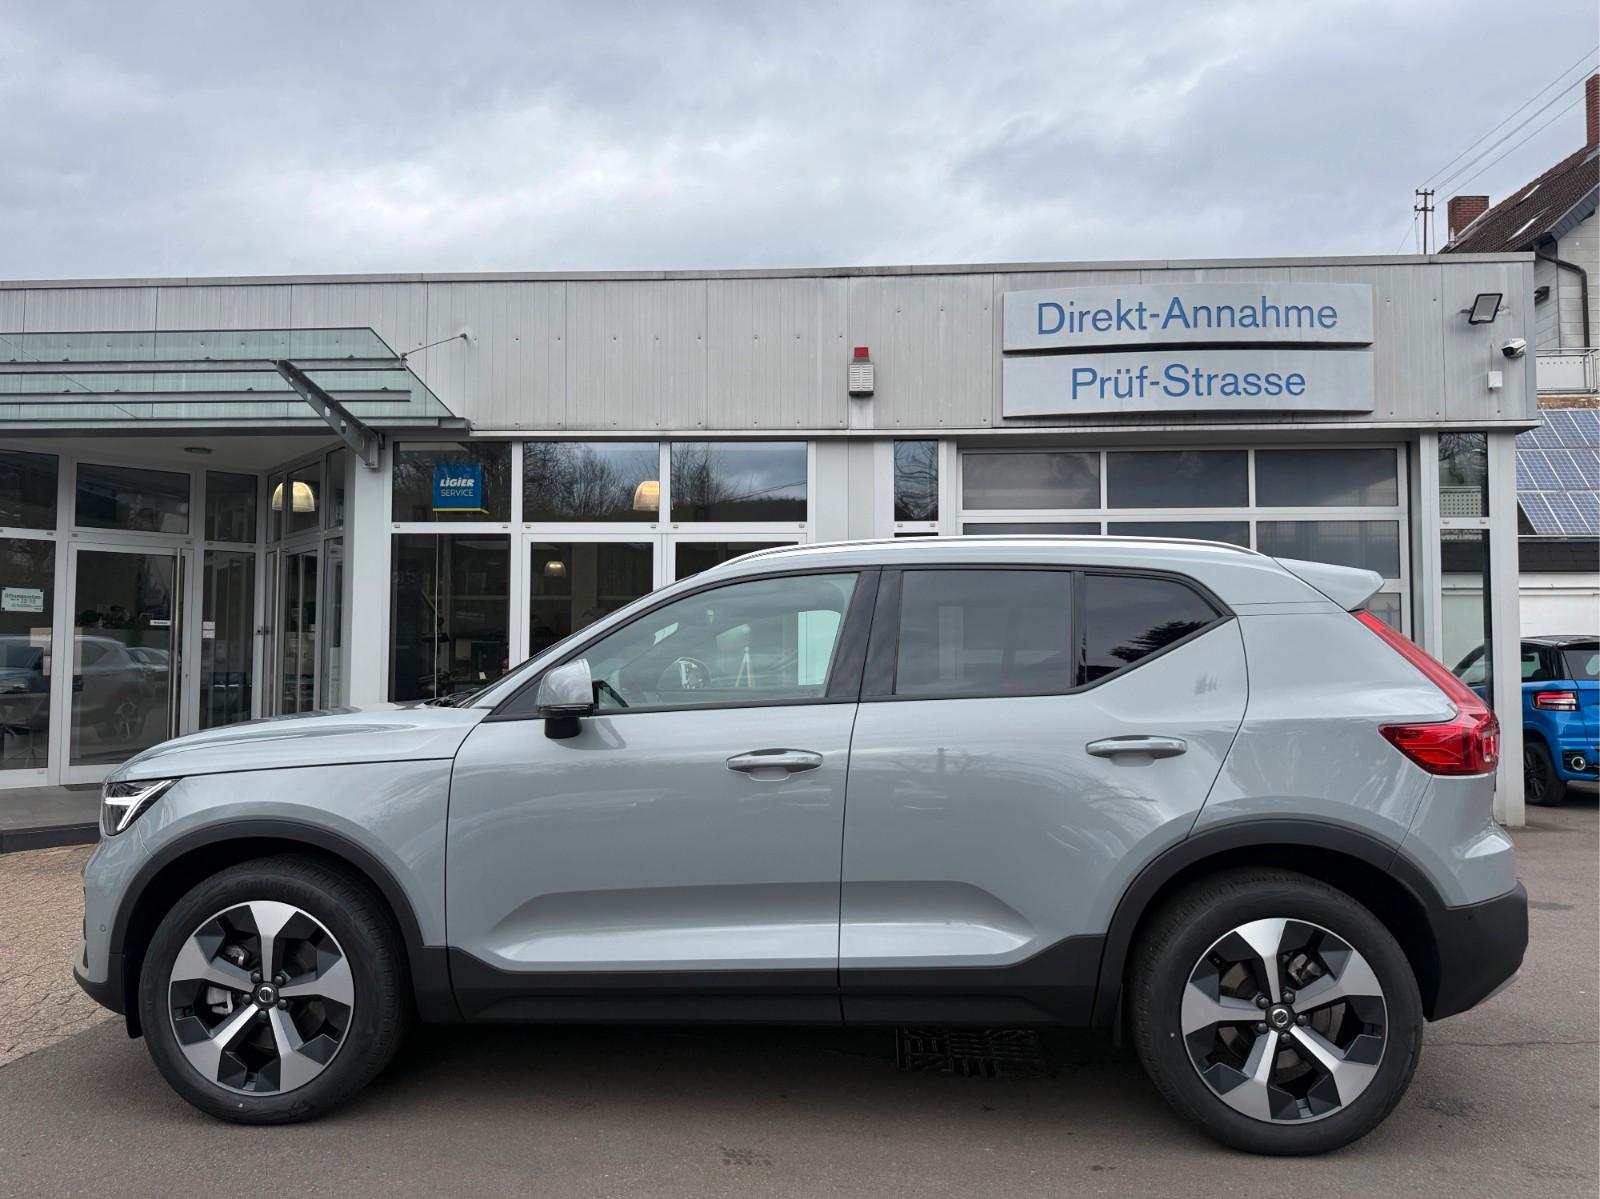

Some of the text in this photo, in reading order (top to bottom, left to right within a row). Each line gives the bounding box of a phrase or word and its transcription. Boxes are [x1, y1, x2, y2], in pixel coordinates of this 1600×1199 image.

[1038, 296, 1337, 335] Direkt-Annahme
[1071, 363, 1306, 399] Prüf-Strasse
[441, 489, 474, 497] SERVICE
